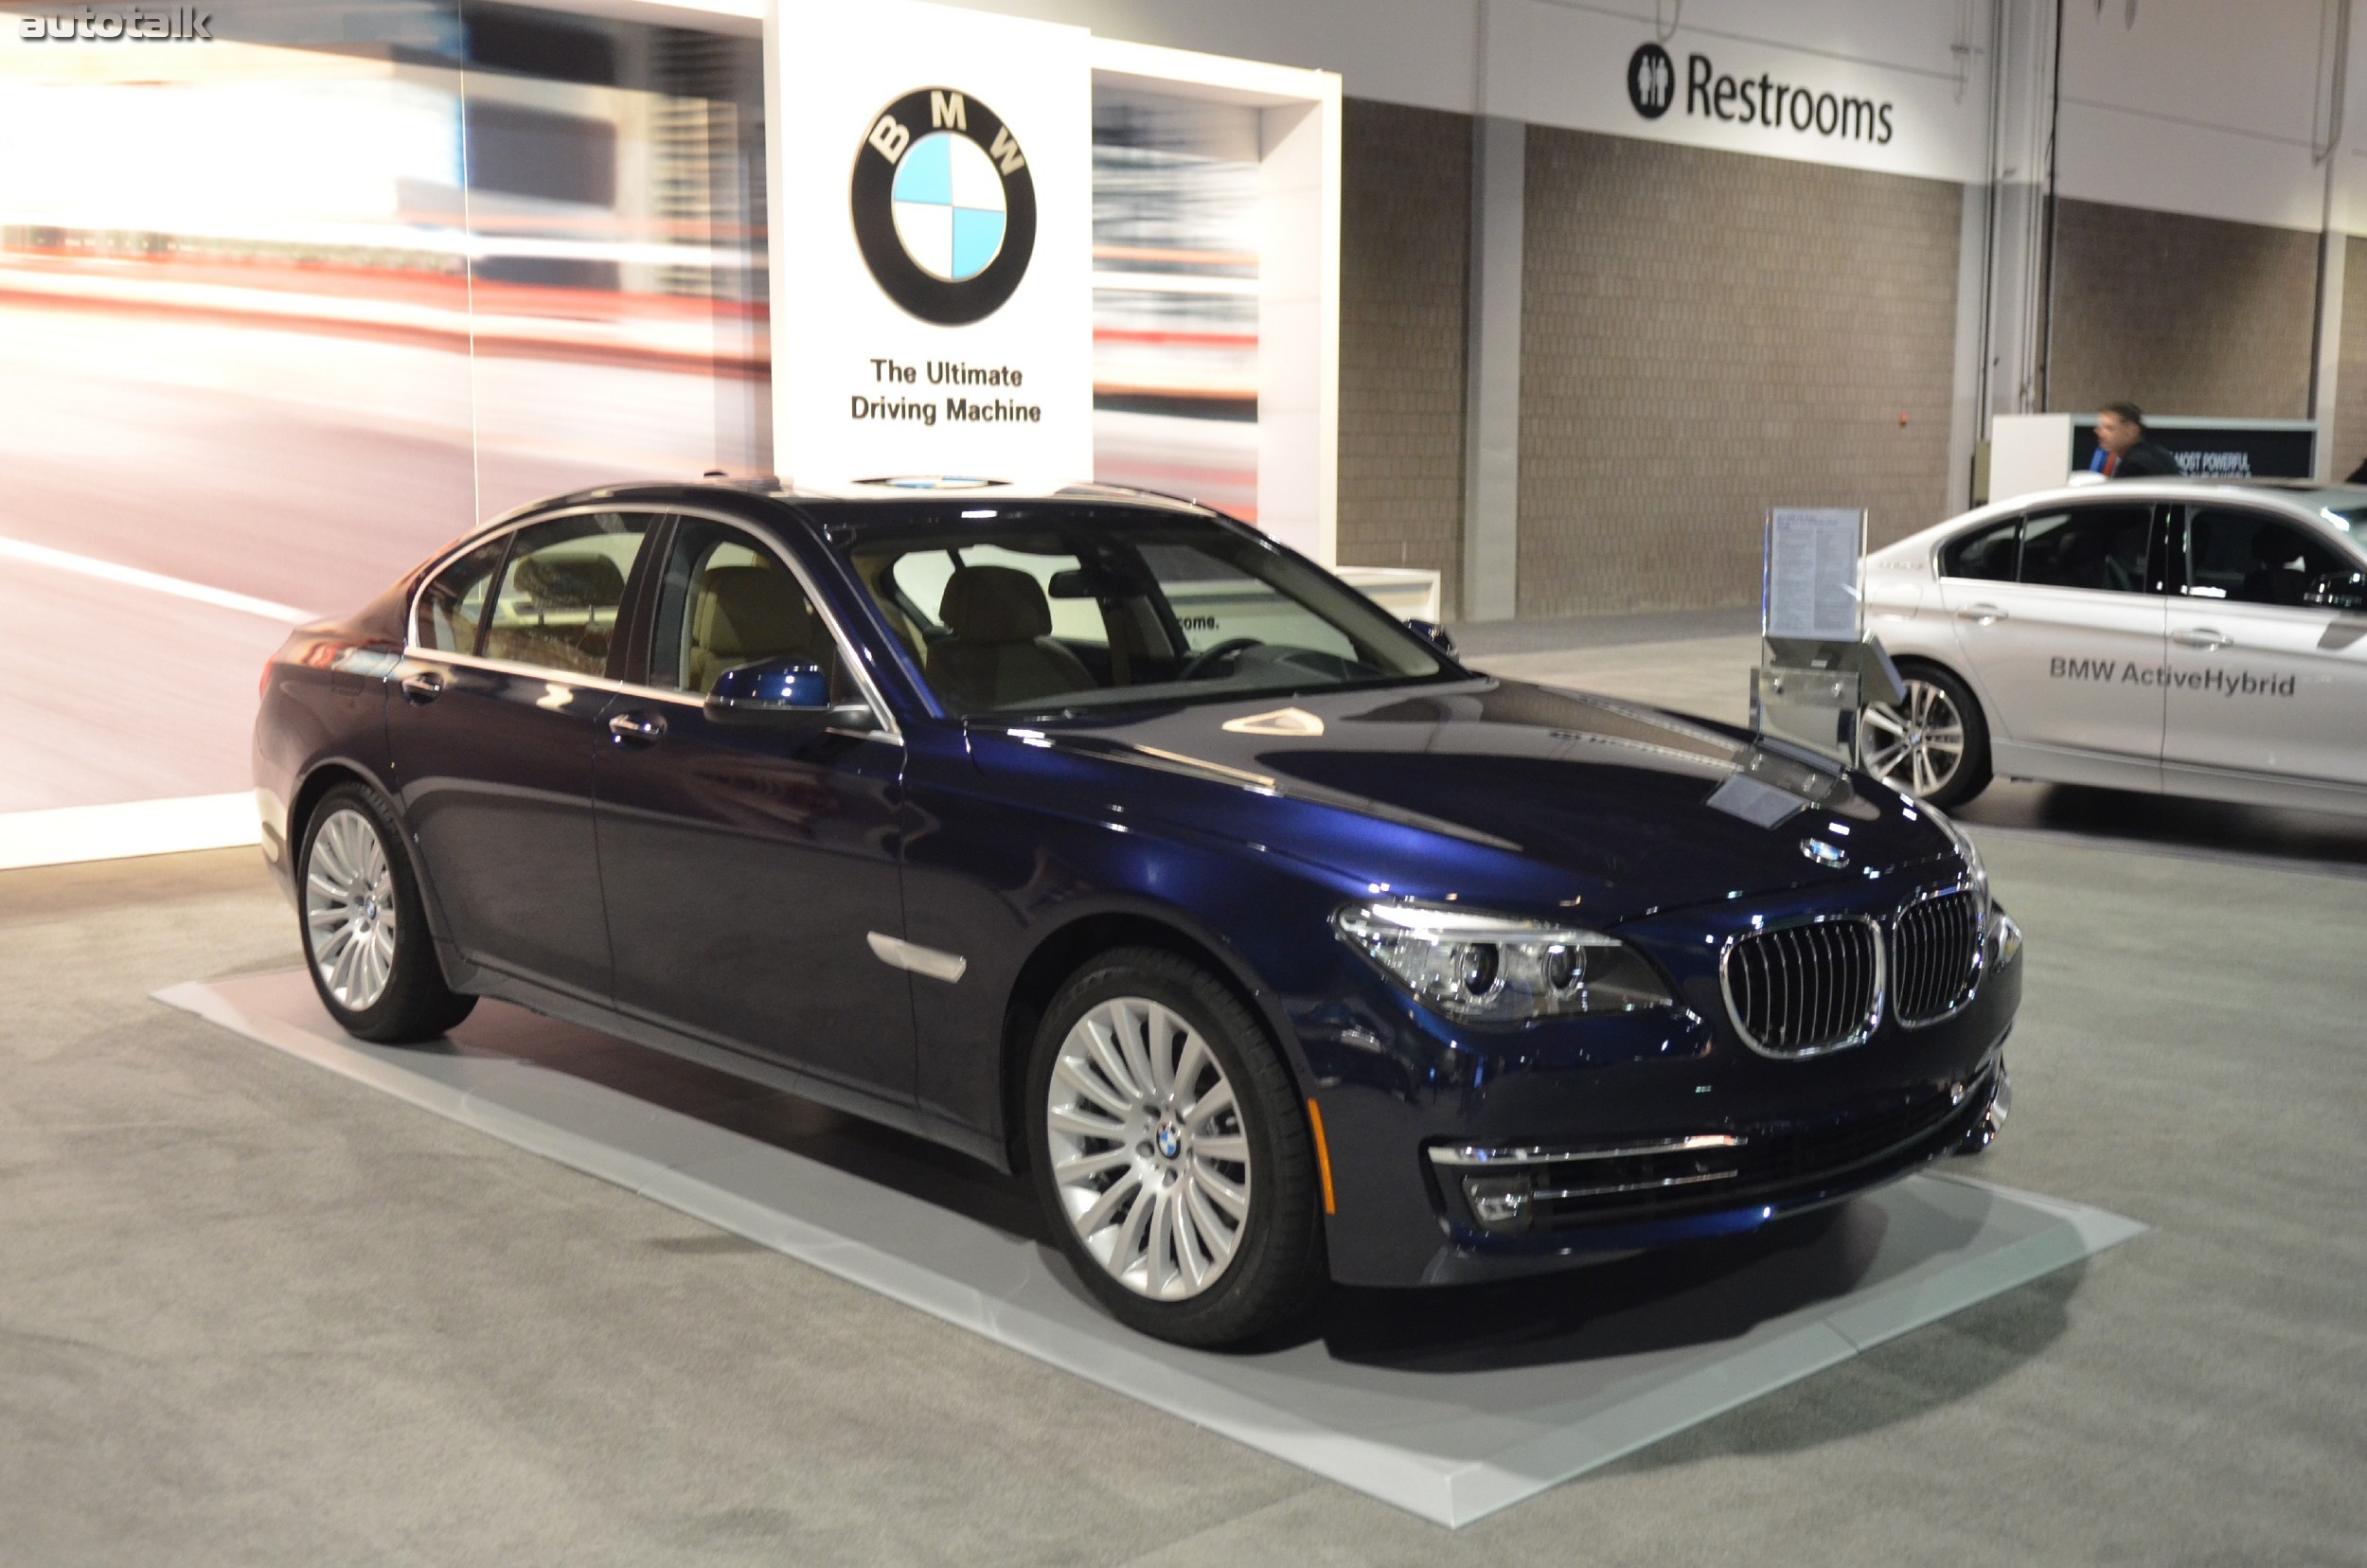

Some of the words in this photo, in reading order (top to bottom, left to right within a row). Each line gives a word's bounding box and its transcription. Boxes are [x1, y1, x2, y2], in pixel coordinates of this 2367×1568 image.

[1687, 53, 1894, 144] Restrooms
[868, 90, 1025, 177] BMW
[870, 359, 917, 383] The
[927, 361, 1023, 386] Ultimate
[852, 396, 936, 425] Driving
[947, 398, 1041, 422] Machine
[2050, 657, 2115, 682] BMW
[2122, 663, 2295, 697] ActiveHybrid
